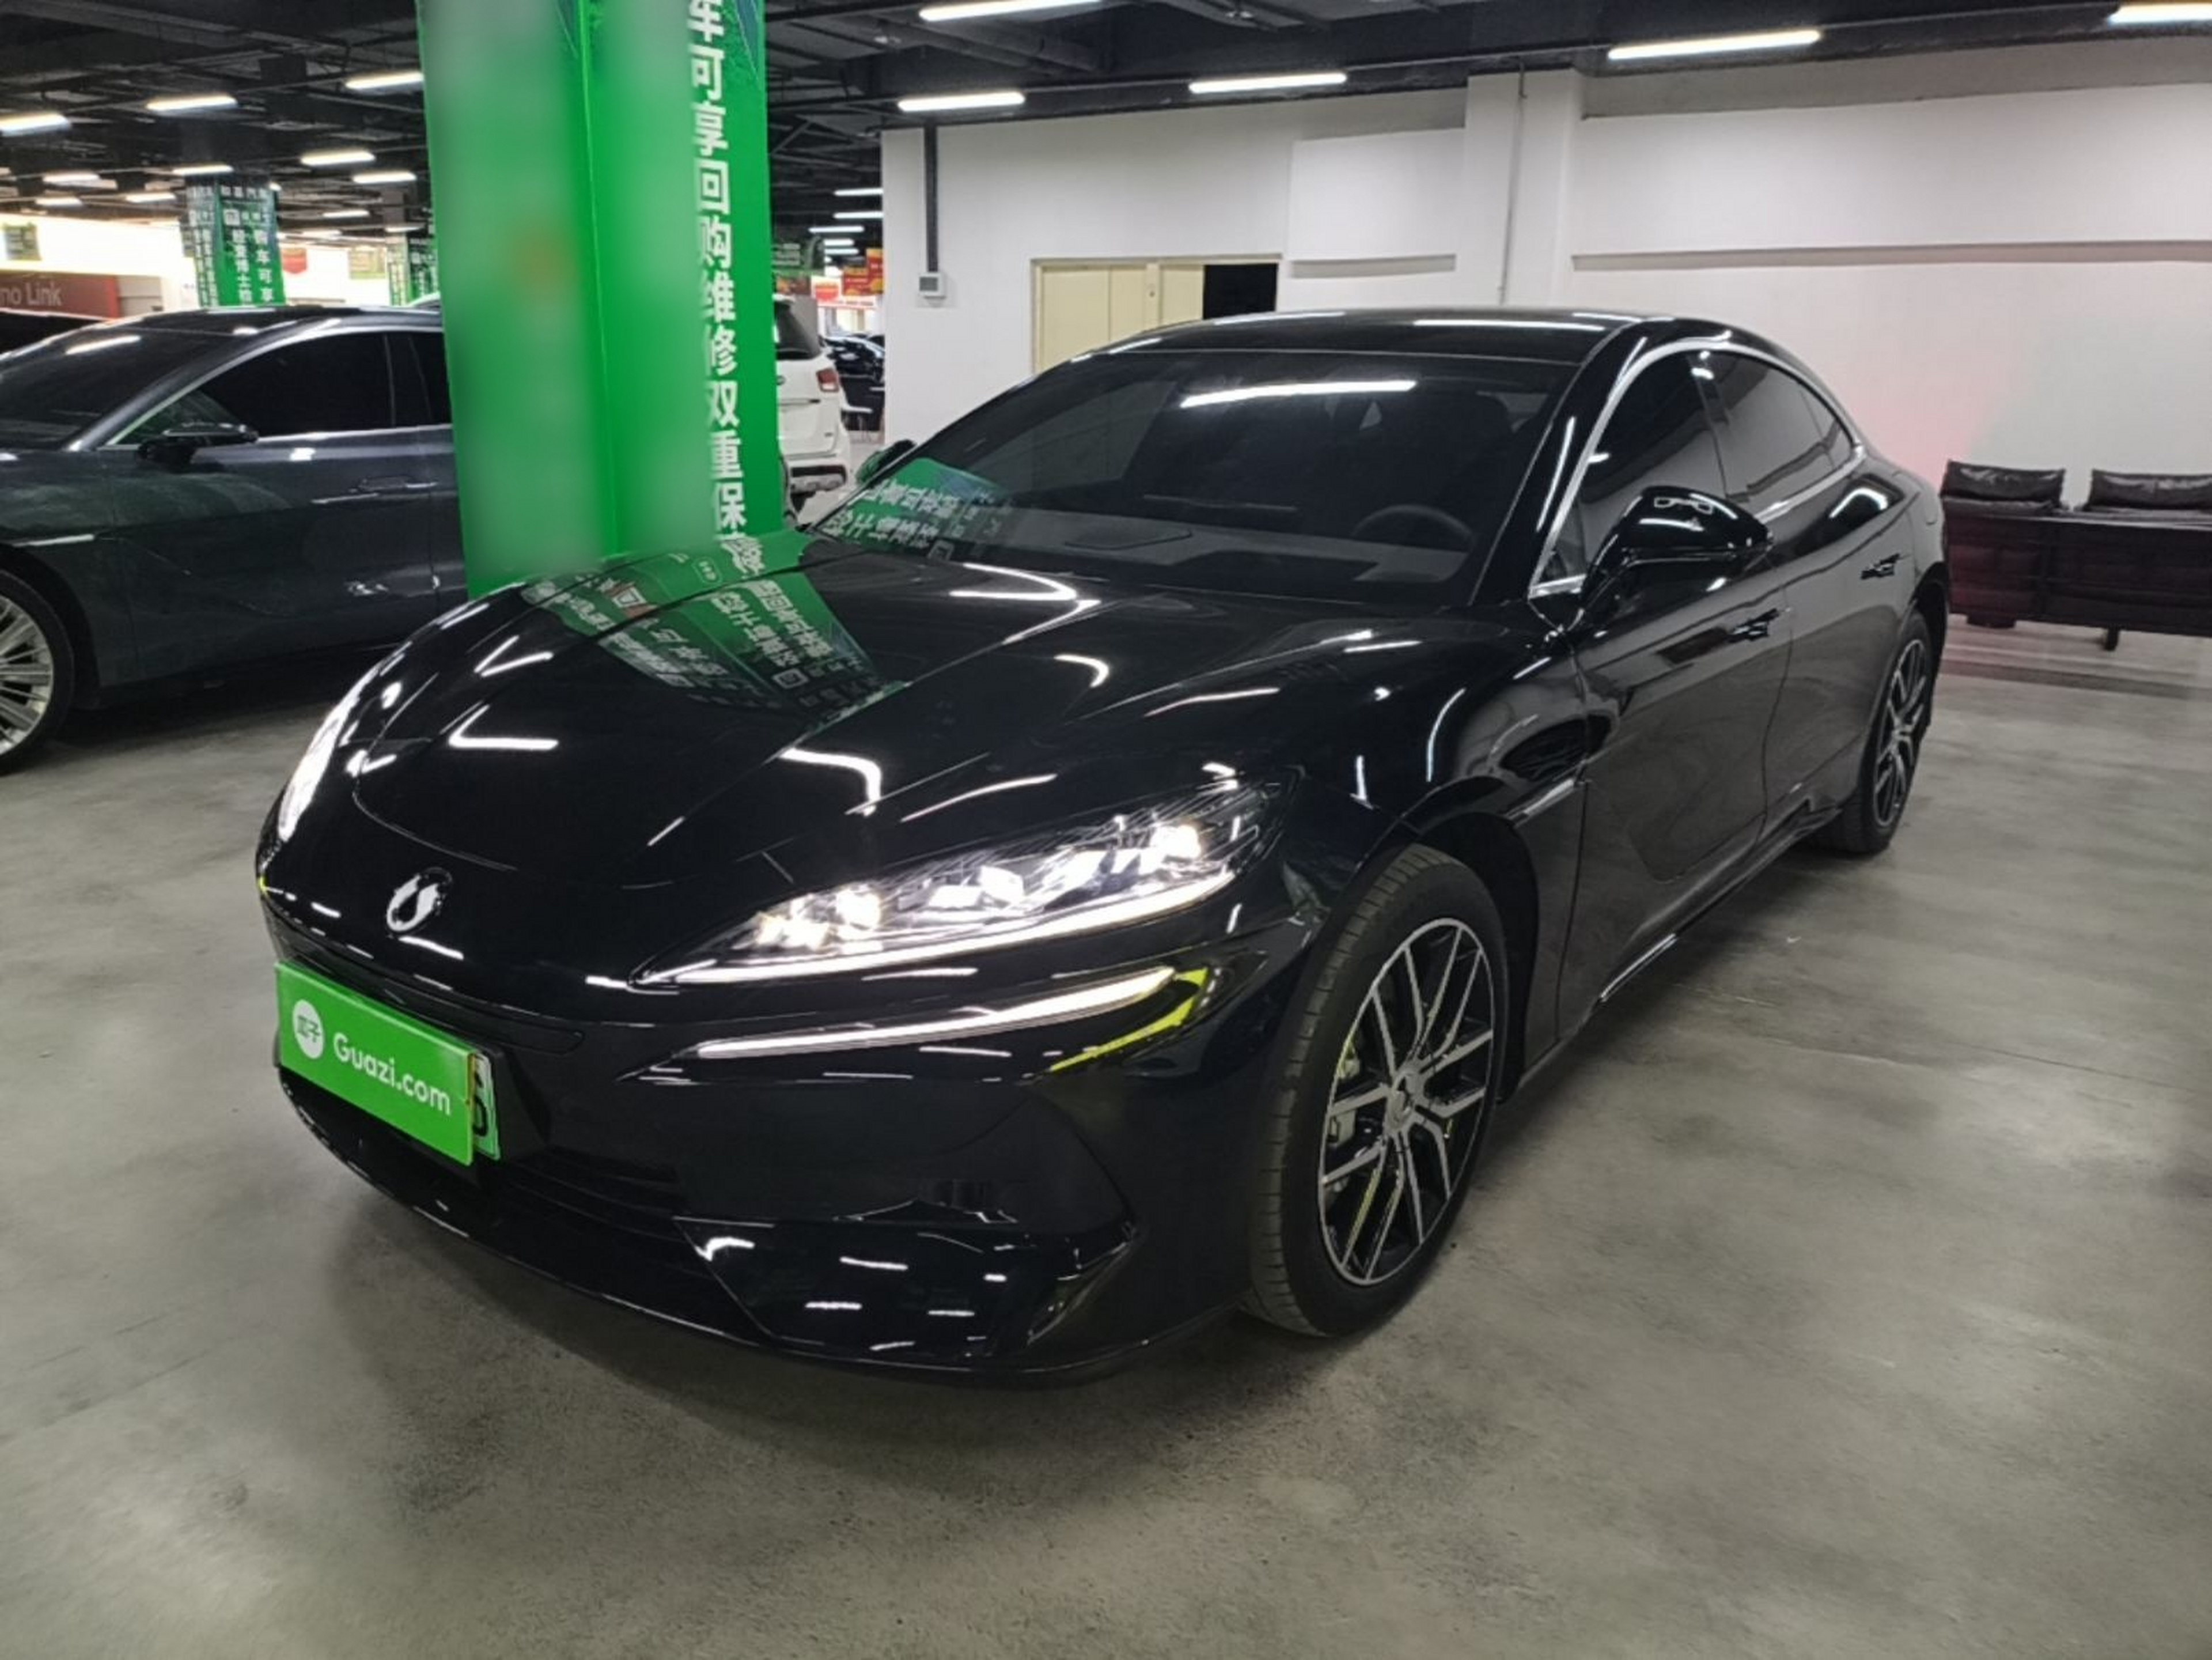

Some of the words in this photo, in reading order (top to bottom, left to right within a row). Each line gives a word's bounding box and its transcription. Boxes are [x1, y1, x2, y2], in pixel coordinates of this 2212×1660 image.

[25, 281, 62, 307] Link
[688, 0, 749, 540] 车可享回购维修双重保
[334, 1032, 451, 1116] Guazi.com
